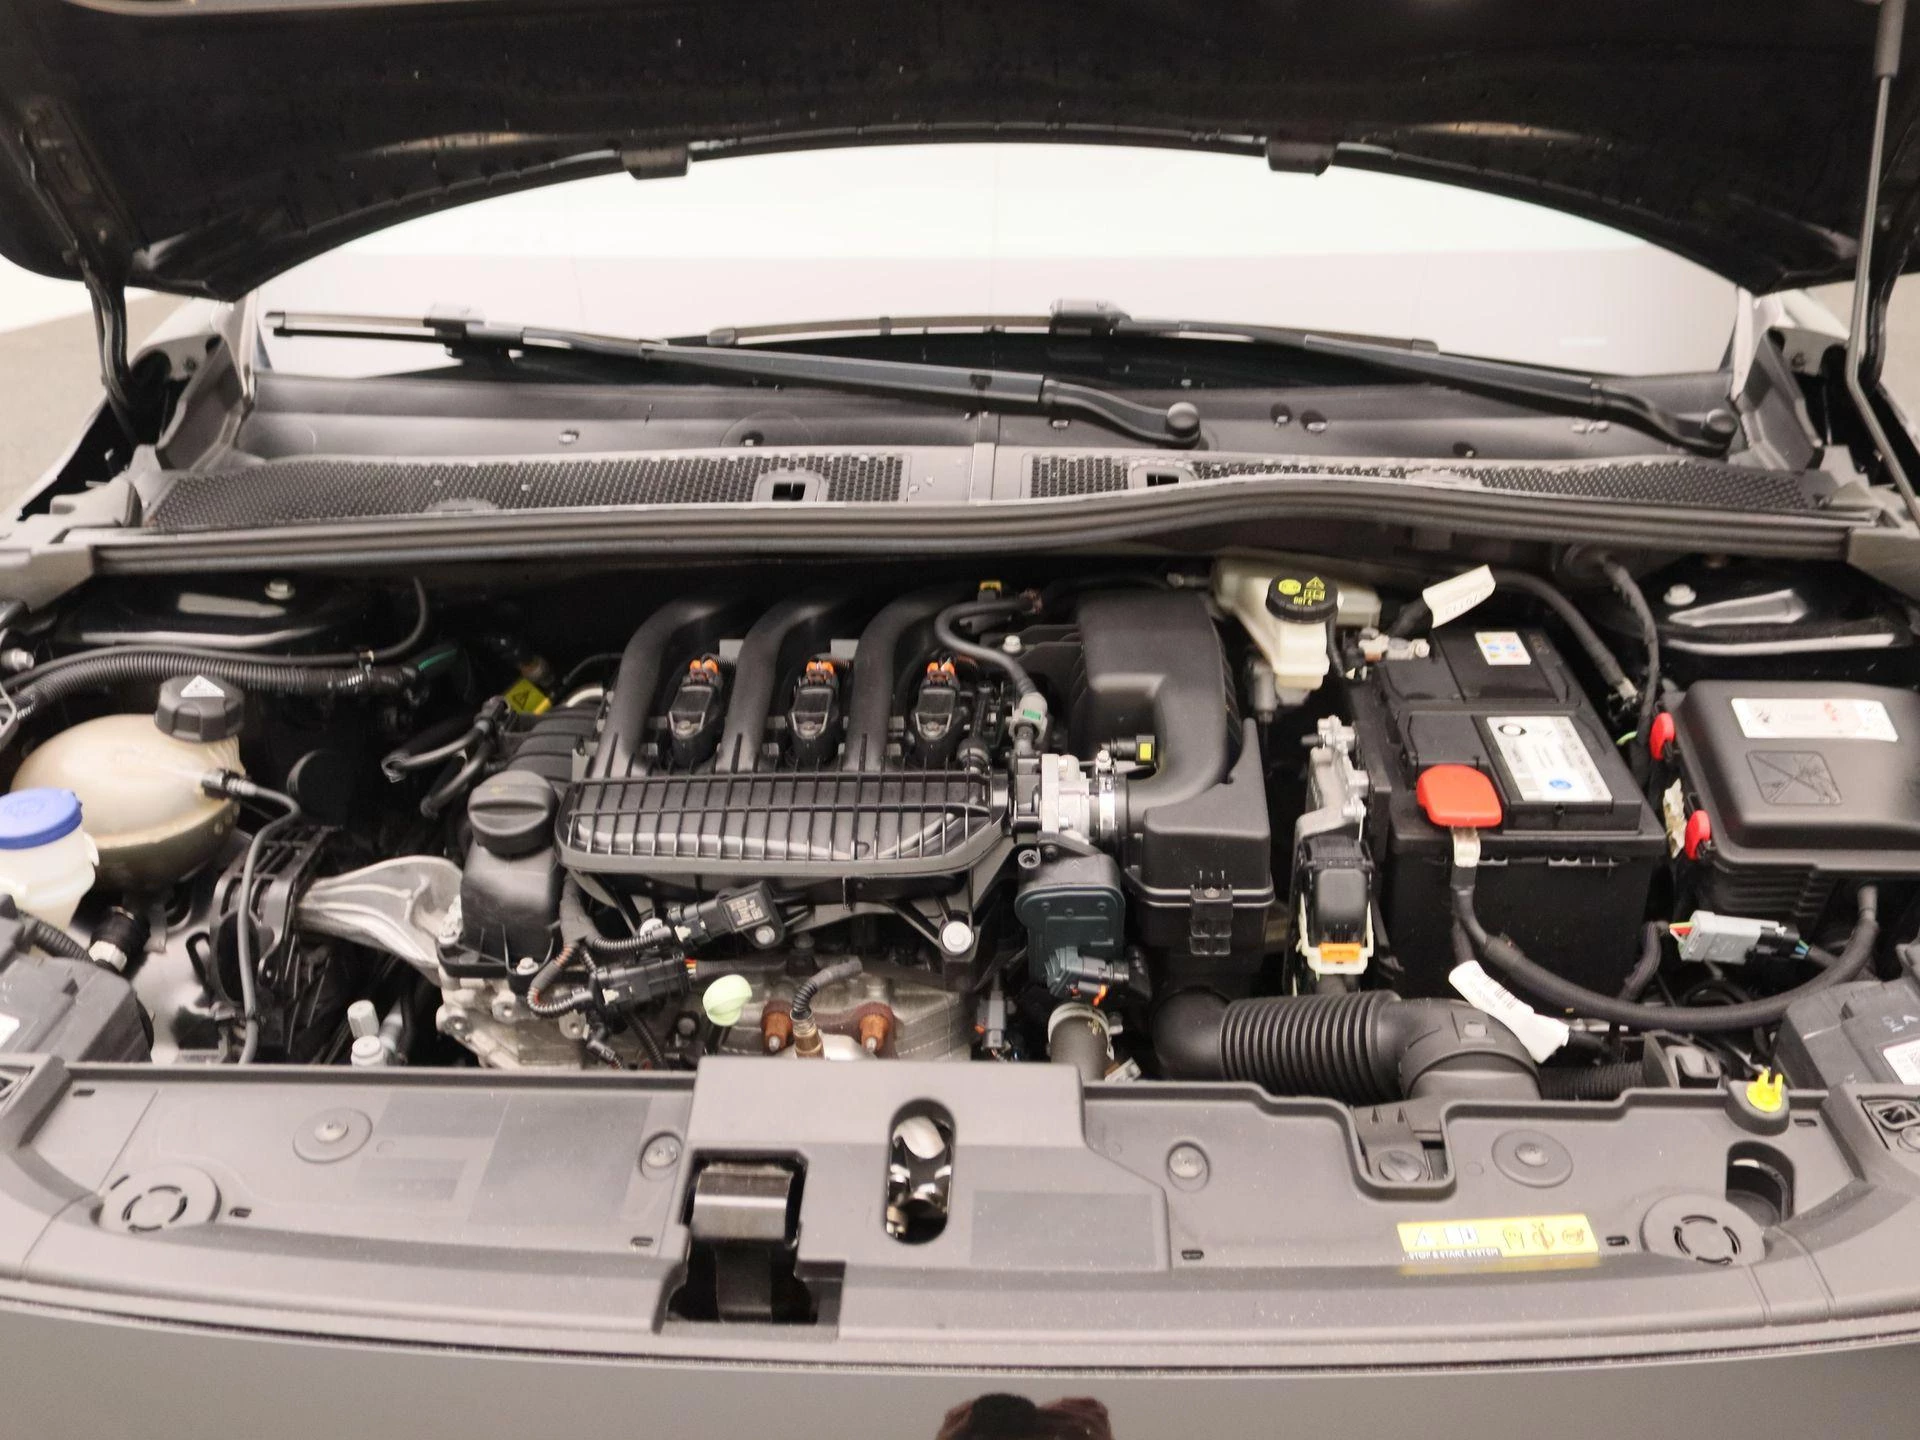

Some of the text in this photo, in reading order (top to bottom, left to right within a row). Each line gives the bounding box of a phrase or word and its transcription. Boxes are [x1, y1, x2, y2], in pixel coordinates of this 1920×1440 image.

[1408, 1251, 1431, 1260] STOP
[1440, 1249, 1466, 1259] START
[1466, 1247, 1498, 1257] SYSTEM
